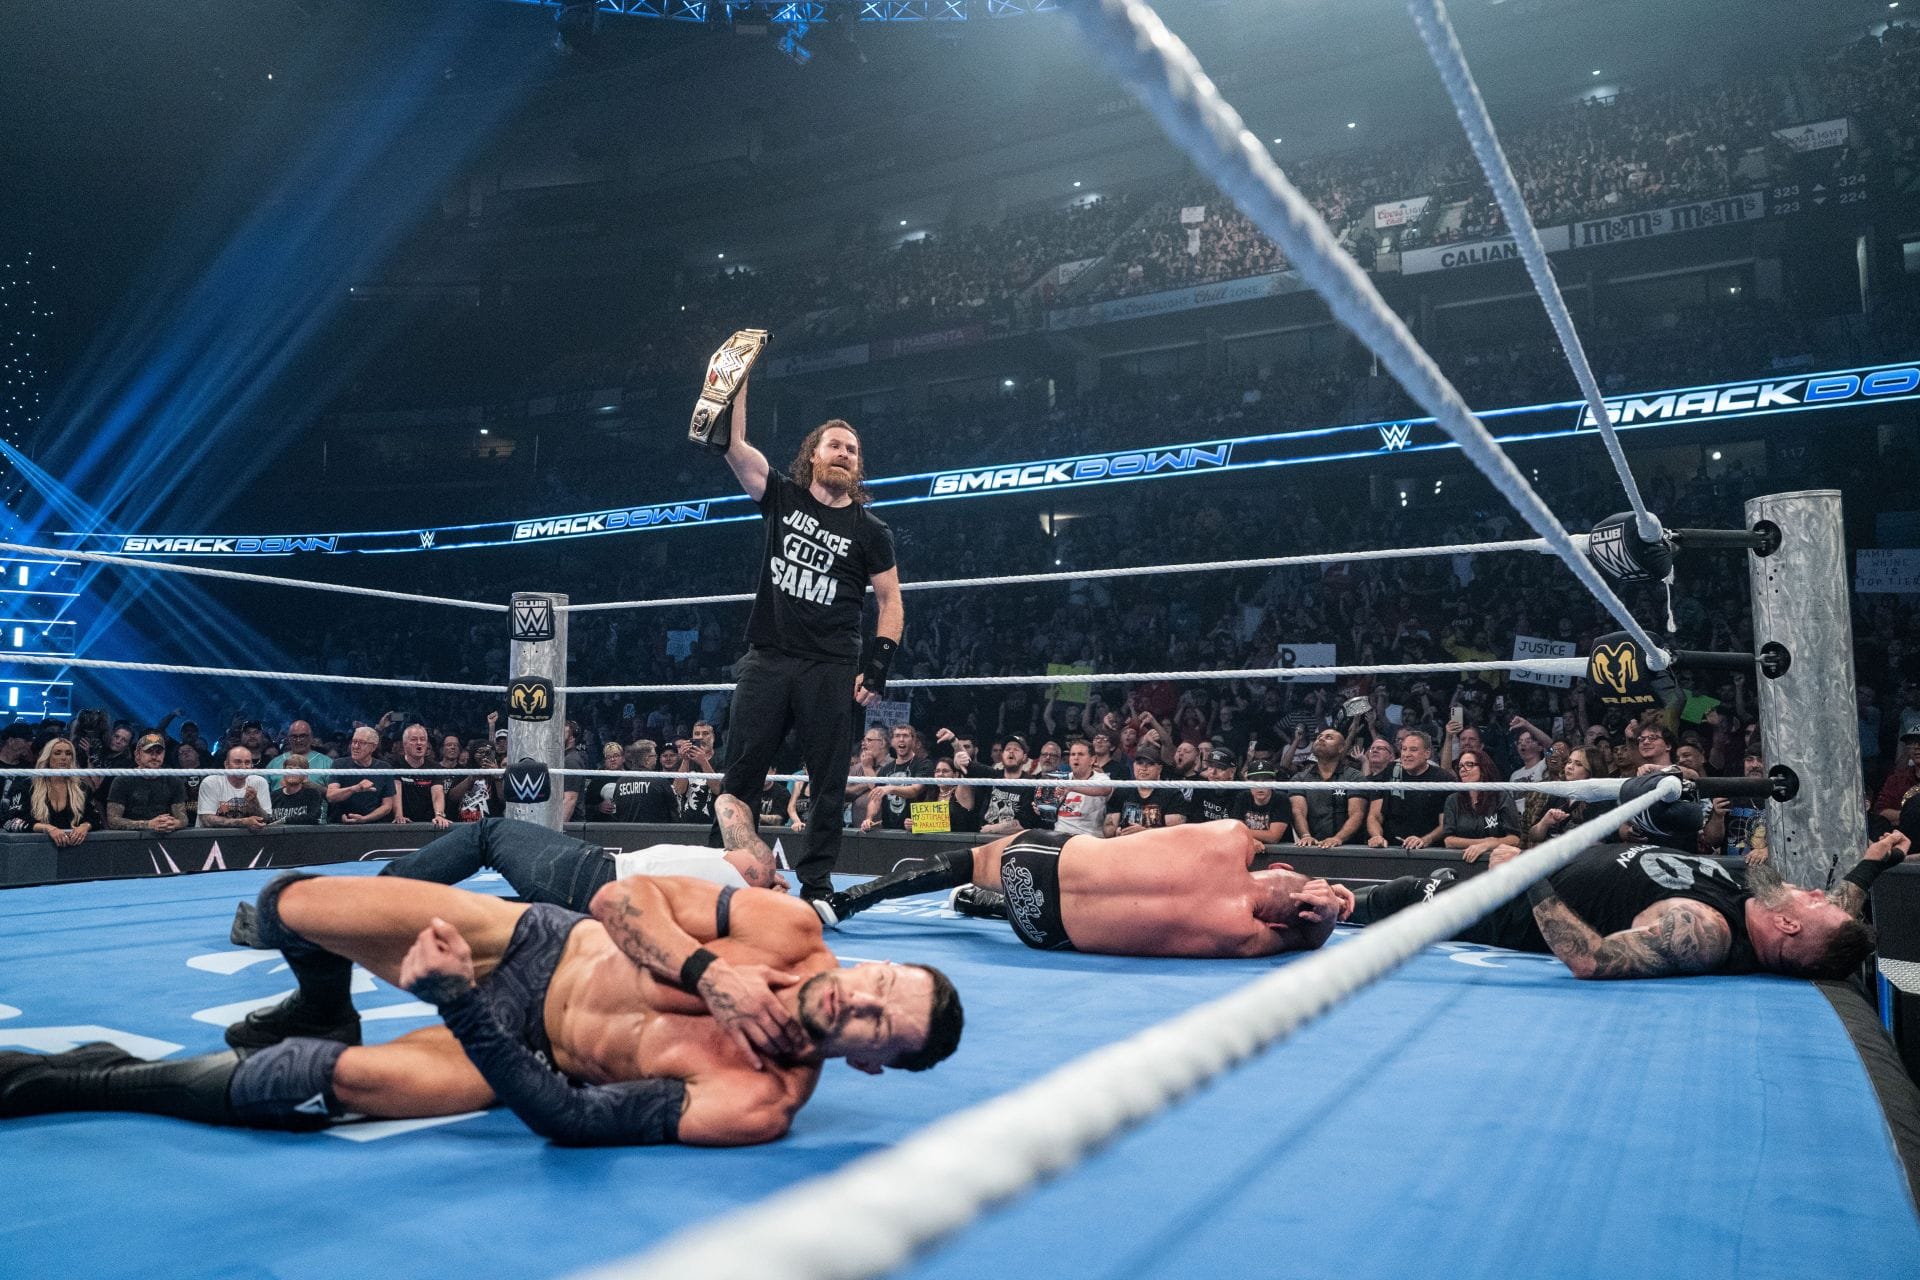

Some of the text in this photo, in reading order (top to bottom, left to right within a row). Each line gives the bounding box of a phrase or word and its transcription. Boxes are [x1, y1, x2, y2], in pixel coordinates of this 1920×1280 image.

[1840, 173, 1866, 187] 324
[1774, 185, 1799, 198] 323
[1840, 190, 1867, 204] 224
[1775, 201, 1800, 215] 223
[1441, 242, 1518, 267] CALIAN
[933, 444, 1228, 495] SMACKDOWN
[515, 503, 706, 539] SMACKDOWN
[1592, 527, 1622, 543] CLUB
[123, 536, 336, 552] SMACKDOWN
[786, 536, 832, 571] FOR
[770, 556, 838, 606] SAMI
[515, 600, 547, 608] CLUB
[1518, 640, 1567, 657] JUSTICE
[1601, 694, 1656, 705] RAM
[619, 781, 650, 796] SECURITY
[911, 803, 949, 814] FLEX ME?
